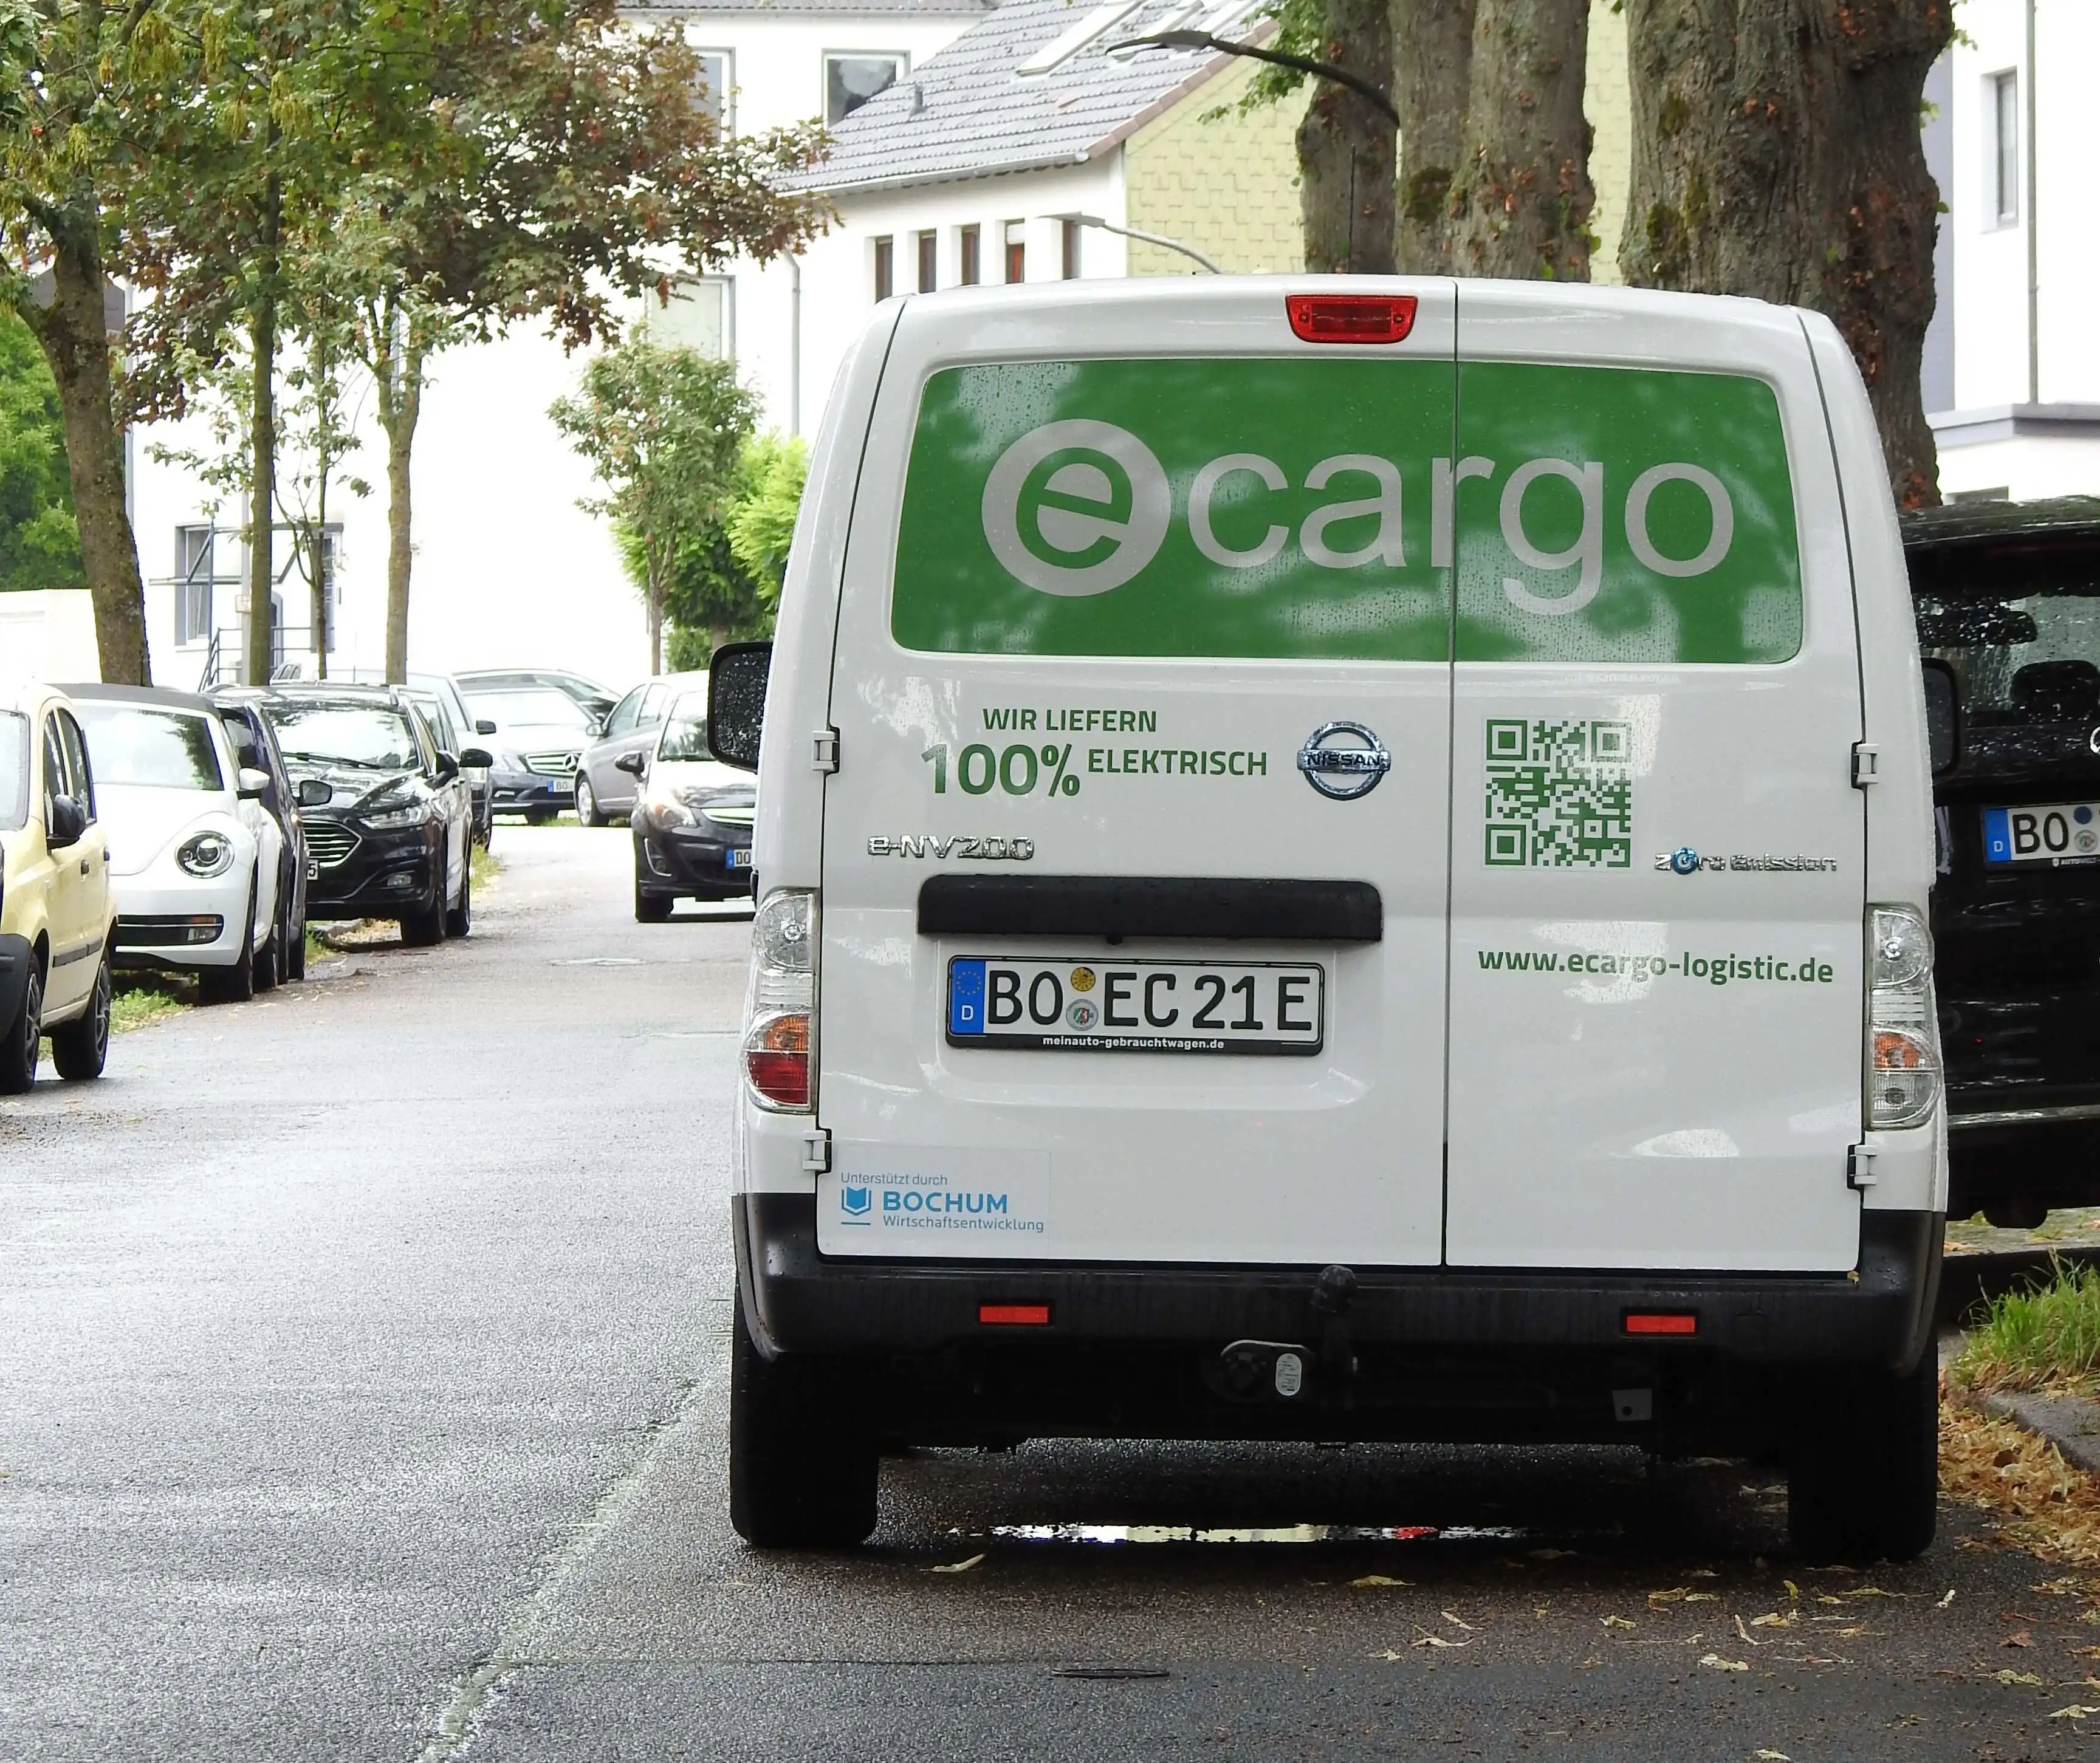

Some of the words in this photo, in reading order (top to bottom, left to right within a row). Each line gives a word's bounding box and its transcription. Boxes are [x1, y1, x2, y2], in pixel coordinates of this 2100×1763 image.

[983, 708, 1037, 731] WIR
[1046, 709, 1157, 732] LIEFERN
[921, 743, 1080, 798] 100%
[1087, 749, 1267, 776] ELEKTRISCH
[1306, 752, 1382, 767] NISSAN
[2012, 812, 2068, 854] BO
[868, 835, 1035, 860] e-NV200
[1994, 841, 2003, 852] D
[1478, 951, 1833, 985] www.ecargo-logistic.de
[987, 970, 1063, 1025] BO
[1104, 972, 1179, 1027] EC
[961, 1005, 973, 1021] D
[1043, 1035, 1225, 1050] meinauto-gebrauchtwagen.de
[841, 1172, 910, 1185] Unterstützt
[912, 1175, 947, 1186] durch
[883, 1191, 1007, 1214] BOCHUM
[883, 1216, 1045, 1233] Wirtschaftsentwicklung
